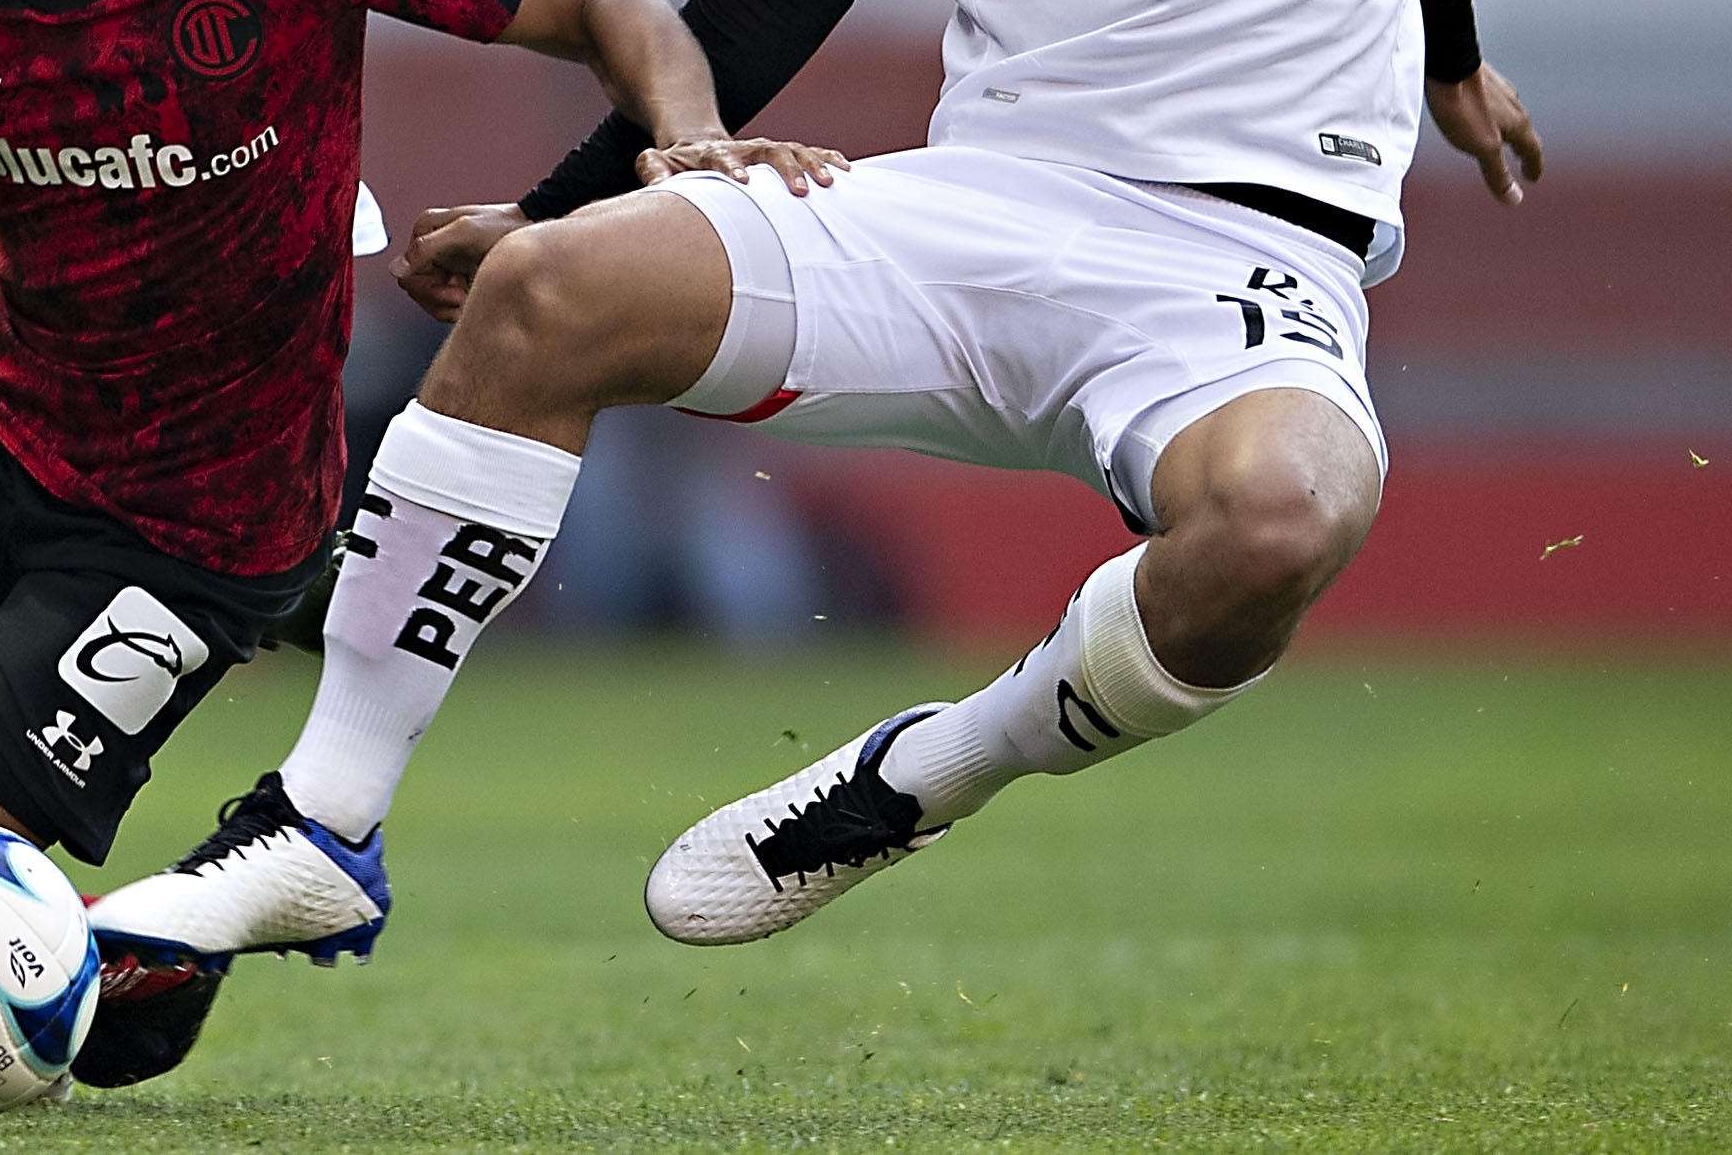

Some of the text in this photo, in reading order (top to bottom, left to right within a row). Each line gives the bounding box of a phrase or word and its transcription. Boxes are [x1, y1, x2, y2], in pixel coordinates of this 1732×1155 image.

[394, 523, 546, 671] PER
[26, 729, 86, 789] UNDER ARMOUR
[9, 937, 45, 978] Voit
